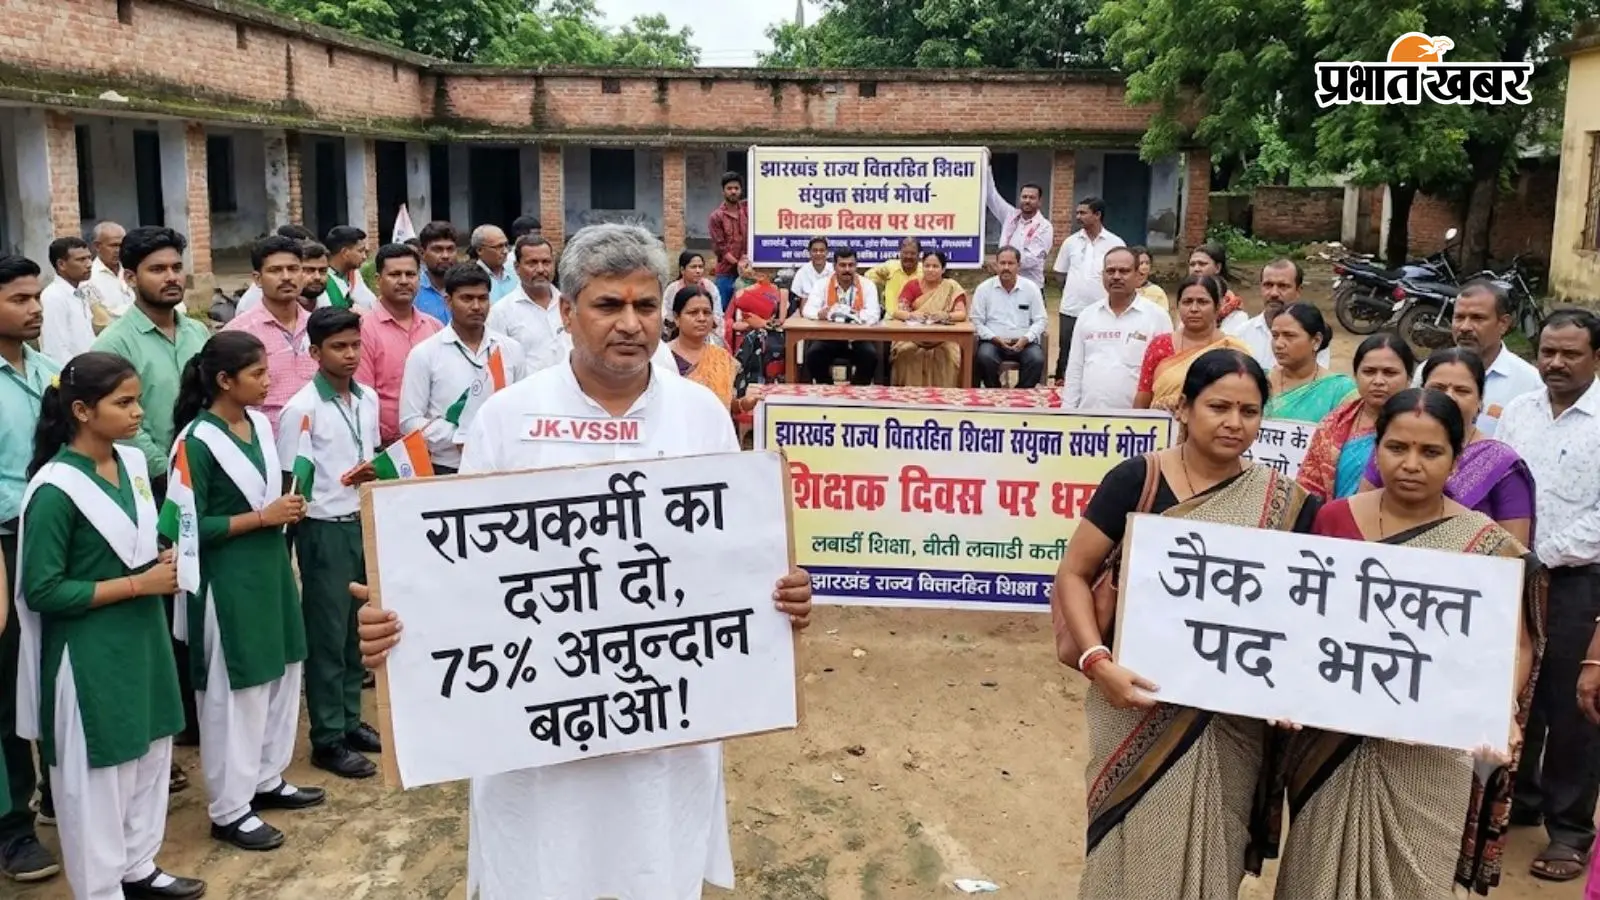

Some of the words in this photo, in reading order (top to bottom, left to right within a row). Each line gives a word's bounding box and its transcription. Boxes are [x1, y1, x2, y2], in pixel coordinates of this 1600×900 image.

[760, 156, 819, 178] झारखंड
[823, 161, 859, 178] राज्य
[777, 209, 833, 230] शिक्षक
[837, 209, 882, 230] दिवस
[888, 213, 908, 230] पर
[914, 212, 956, 230] धरना
[798, 183, 847, 208] संयुक्त
[852, 183, 890, 204] संघर्ष
[528, 418, 640, 441] JK-VSSM
[775, 415, 836, 447] झारखंड
[841, 424, 880, 449] राज्य
[959, 420, 1005, 453] शिक्षा
[1010, 421, 1064, 464] संयुक्त
[1069, 424, 1111, 457] संघर्ष
[421, 471, 648, 564] राज्यकर्मी
[662, 482, 729, 533] का
[899, 465, 986, 515] दिवस
[997, 480, 1040, 517] पर
[1052, 482, 1100, 519] धर
[869, 532, 917, 558] शिक्षा,
[499, 546, 602, 625] दर्जा
[618, 543, 685, 609] दो,
[811, 571, 871, 591] झारखंड
[996, 575, 1039, 598] शिक्षा
[1158, 531, 1266, 607] जैक
[1287, 549, 1336, 617] में
[1355, 557, 1482, 637] रिक्त
[431, 636, 537, 699] 75%
[554, 607, 755, 683] अनुन्दान
[1184, 619, 1287, 688] पद
[1318, 631, 1432, 704] भरो
[524, 675, 690, 752] बढ़ाओ!
